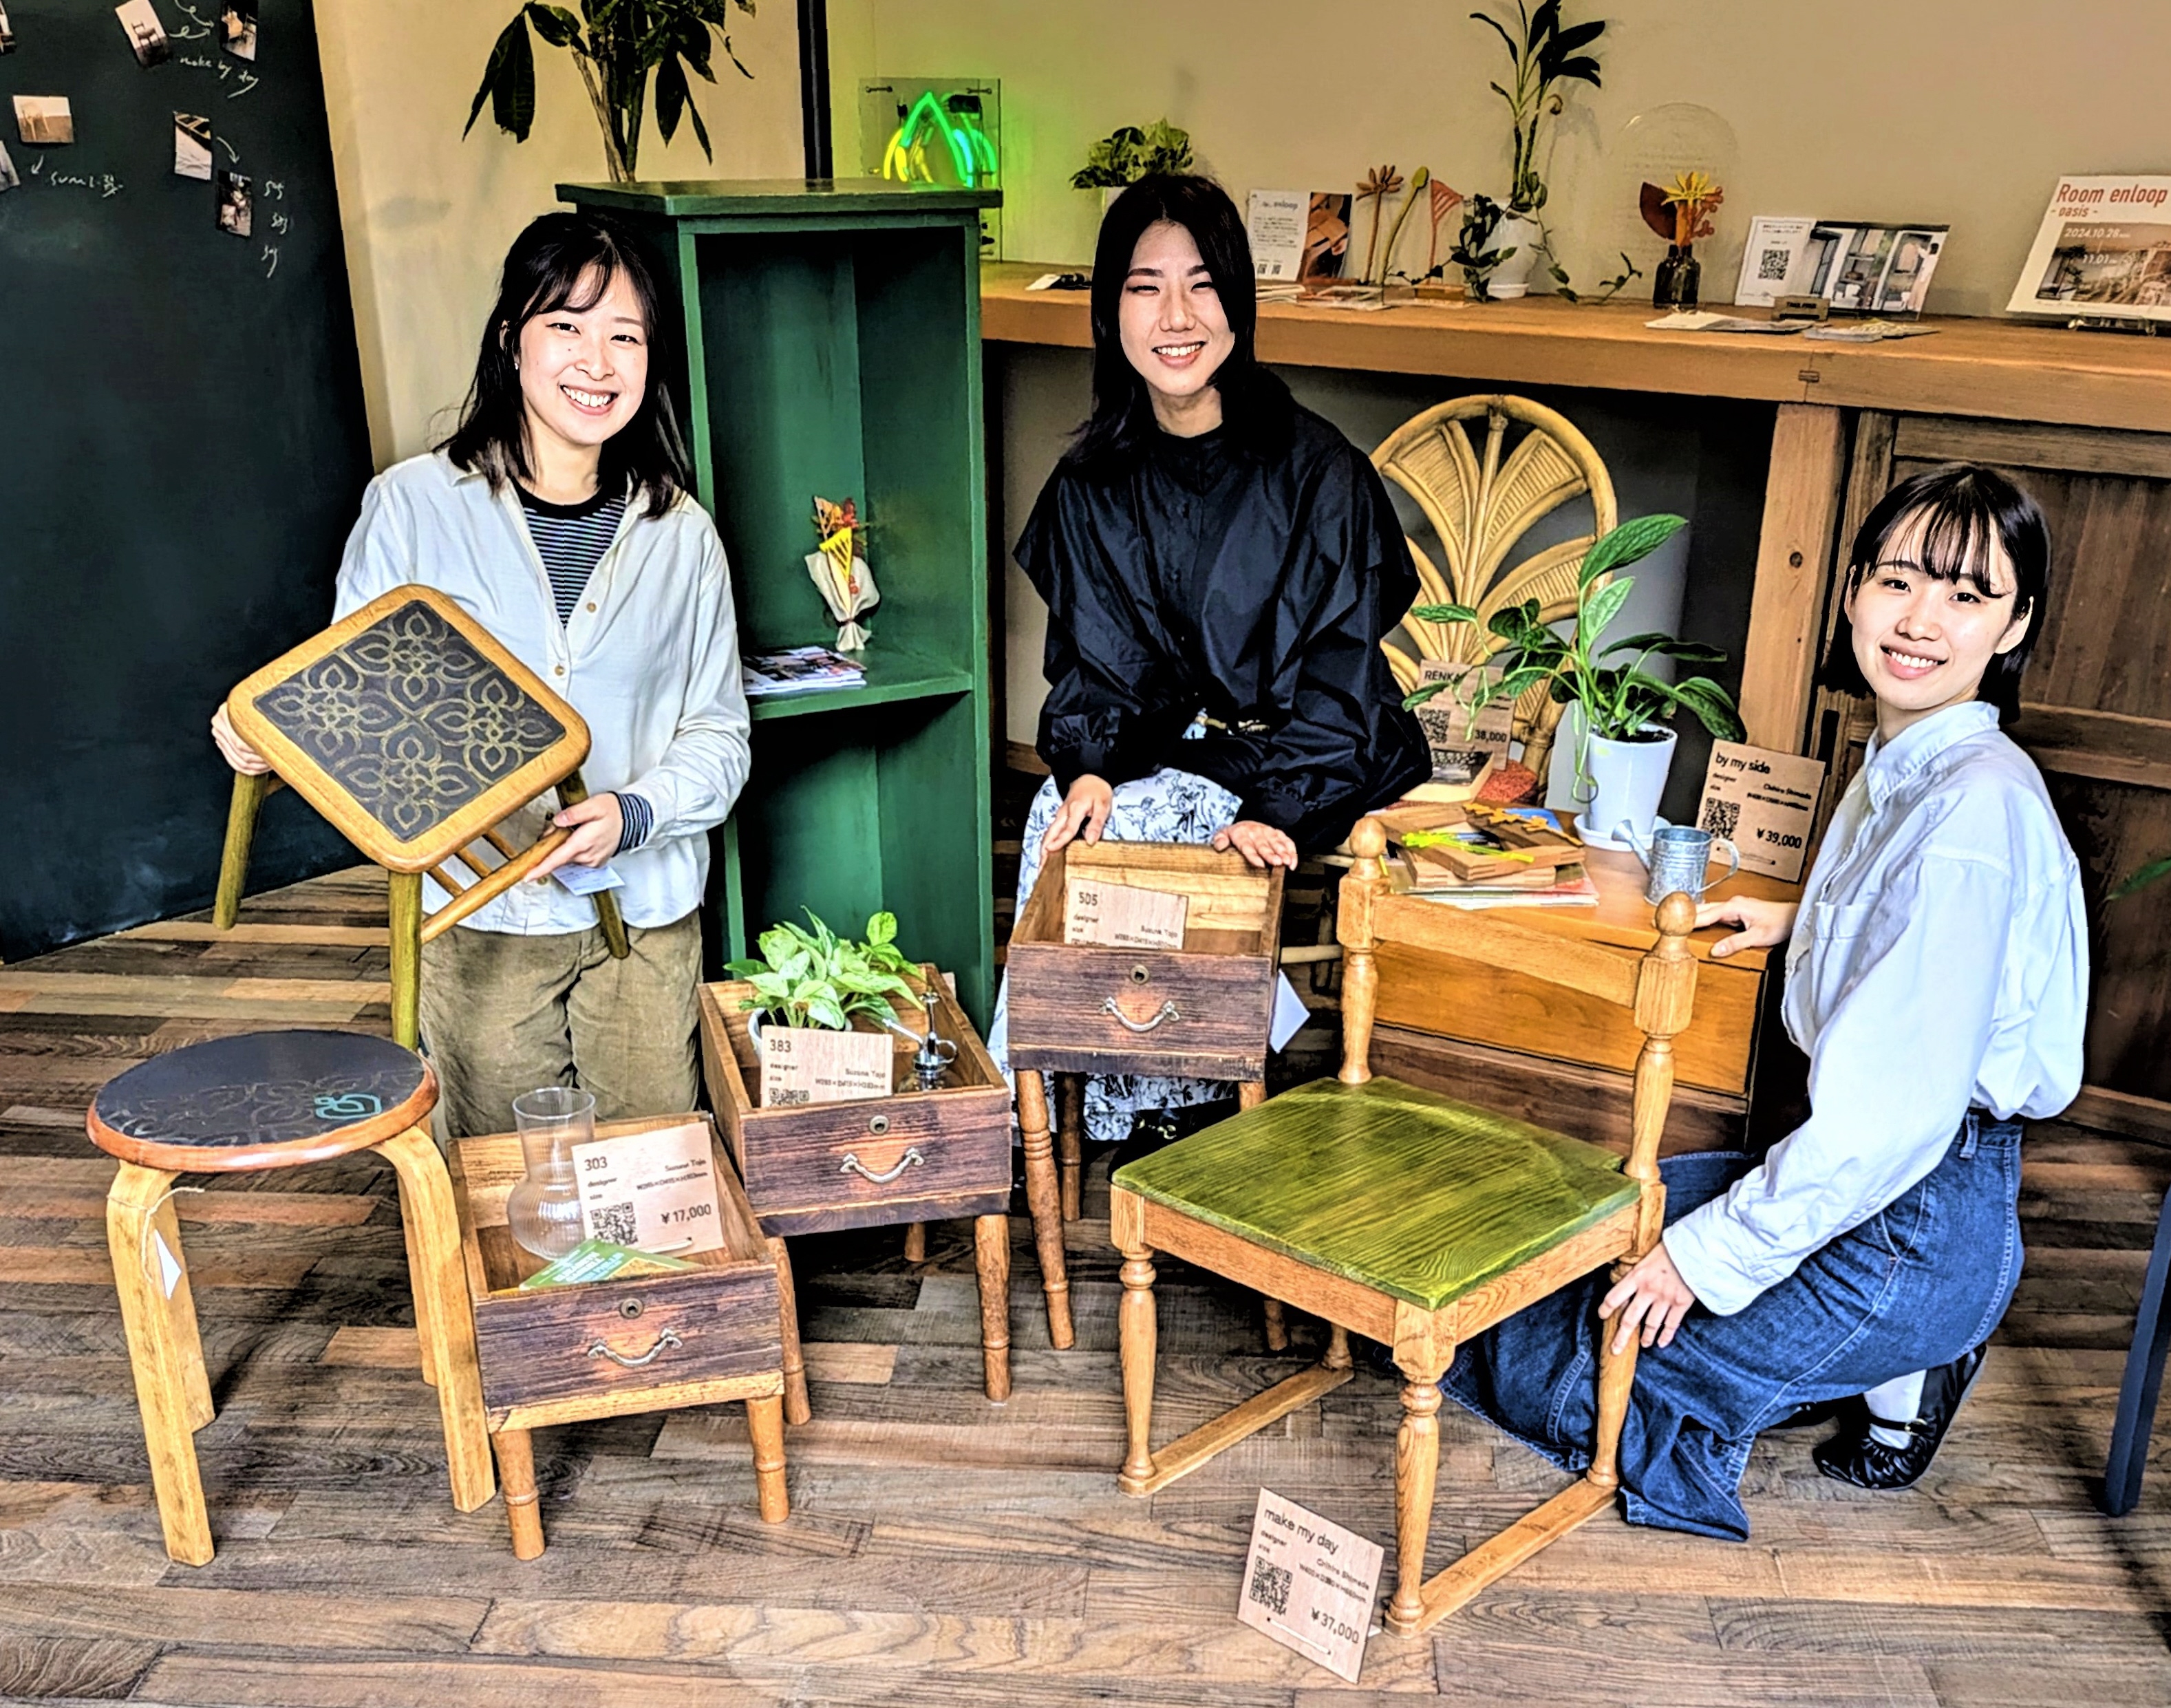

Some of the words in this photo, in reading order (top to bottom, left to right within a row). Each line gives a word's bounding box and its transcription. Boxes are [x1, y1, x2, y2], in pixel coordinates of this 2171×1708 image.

[2056, 184, 2104, 204] Room
[2110, 184, 2169, 208] enloop
[2059, 205, 2089, 217] oasis
[1715, 751, 1729, 767] by
[1731, 758, 1747, 772] my
[1748, 759, 1771, 775] side
[1766, 830, 1803, 849] 39,000
[1078, 892, 1098, 906] 505
[769, 1039, 792, 1054] 383
[769, 1062, 800, 1072] designer
[584, 1156, 608, 1171] 303
[587, 1176, 618, 1188] designer
[673, 1204, 712, 1223] 17,000
[1260, 1529, 1287, 1547] designer
[1263, 1508, 1296, 1531] make
[1296, 1524, 1316, 1544] my
[1317, 1533, 1339, 1555] day
[1320, 1613, 1360, 1645] 37,000
